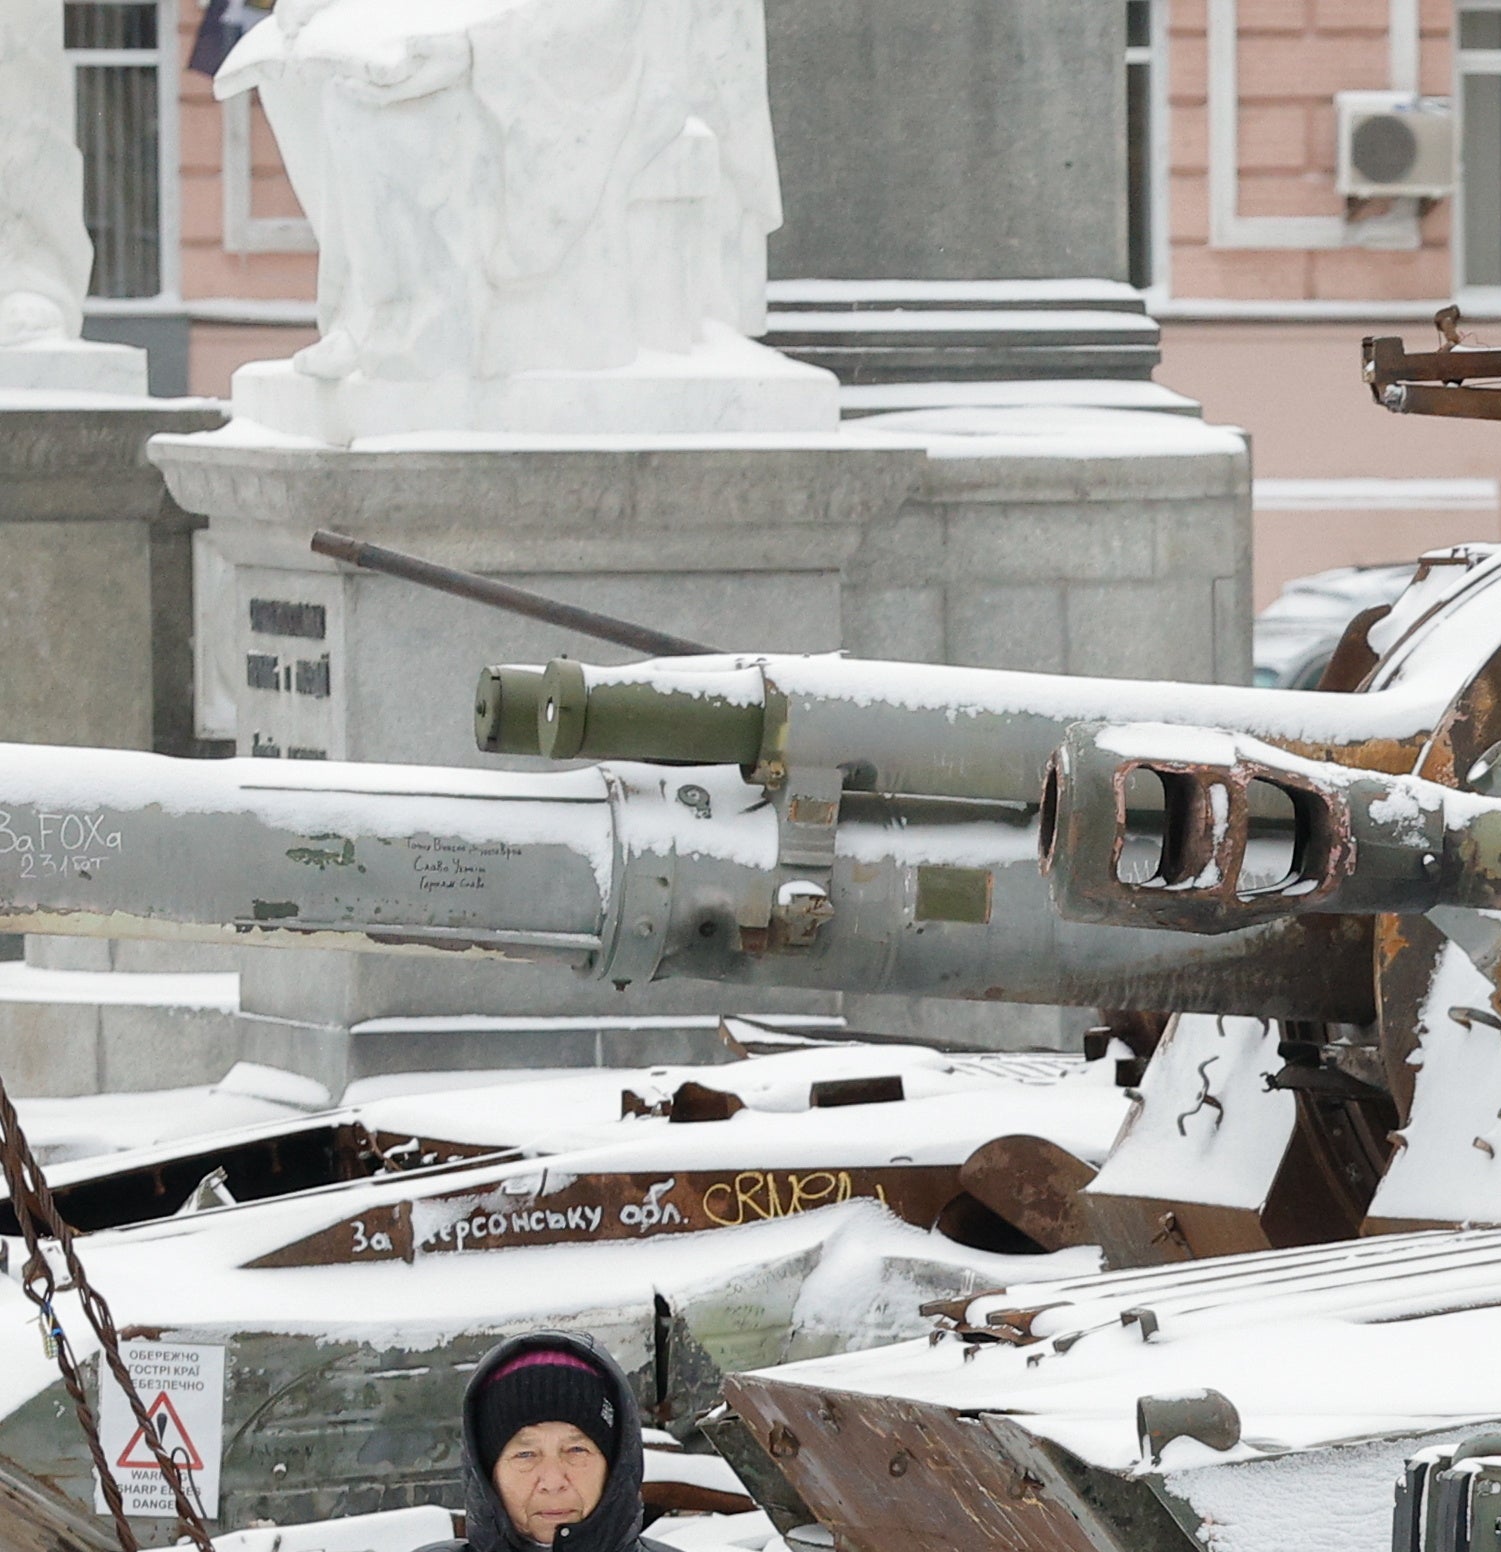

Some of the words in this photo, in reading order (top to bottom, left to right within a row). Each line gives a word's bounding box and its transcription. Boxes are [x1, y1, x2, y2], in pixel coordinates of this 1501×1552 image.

[413, 1205, 602, 1252] ерсонську
[129, 1350, 200, 1363] ОБЕРЕЖНО
[128, 1364, 171, 1375] ГОСТРІ
[173, 1366, 201, 1377] КРАЇ
[130, 1379, 205, 1392] ЕБЕЗПЕЧНО
[132, 1498, 176, 1510] DANGE
